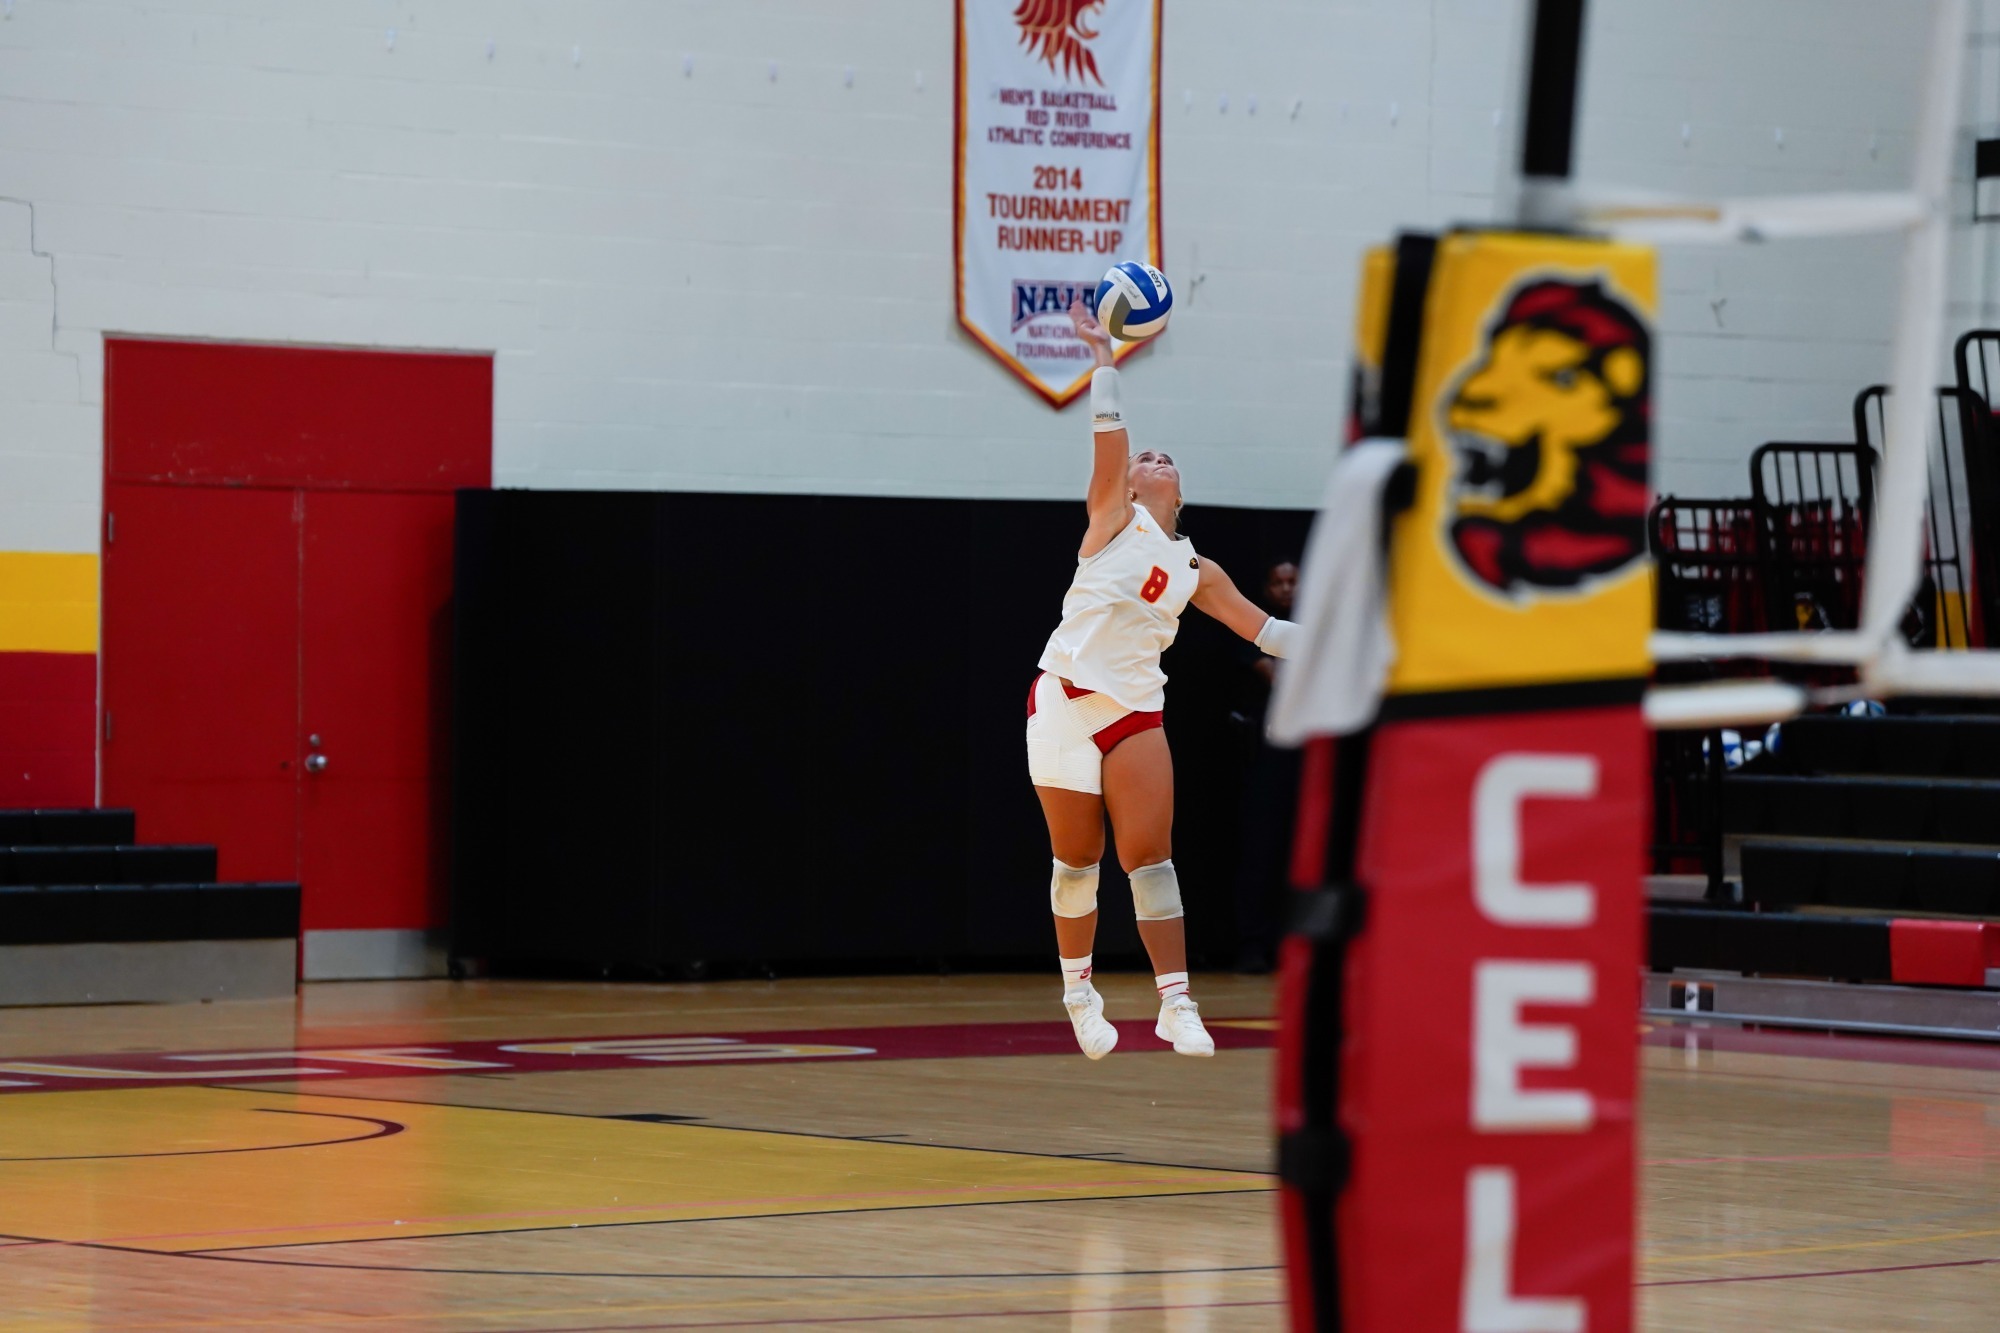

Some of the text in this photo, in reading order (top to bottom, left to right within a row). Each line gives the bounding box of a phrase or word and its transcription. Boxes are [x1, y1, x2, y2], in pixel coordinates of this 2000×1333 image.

[1041, 90, 1117, 111] BASKETBALL
[1026, 110, 1091, 128] RED RIVER
[987, 127, 1131, 150] ATHLETIC CONFERENCE
[1033, 165, 1082, 190] 2014
[986, 193, 1131, 223] TOURNAMENT
[997, 226, 1122, 255] RUNNER-UP
[1140, 565, 1169, 604] 8
[0, 1036, 878, 1088] LTS
